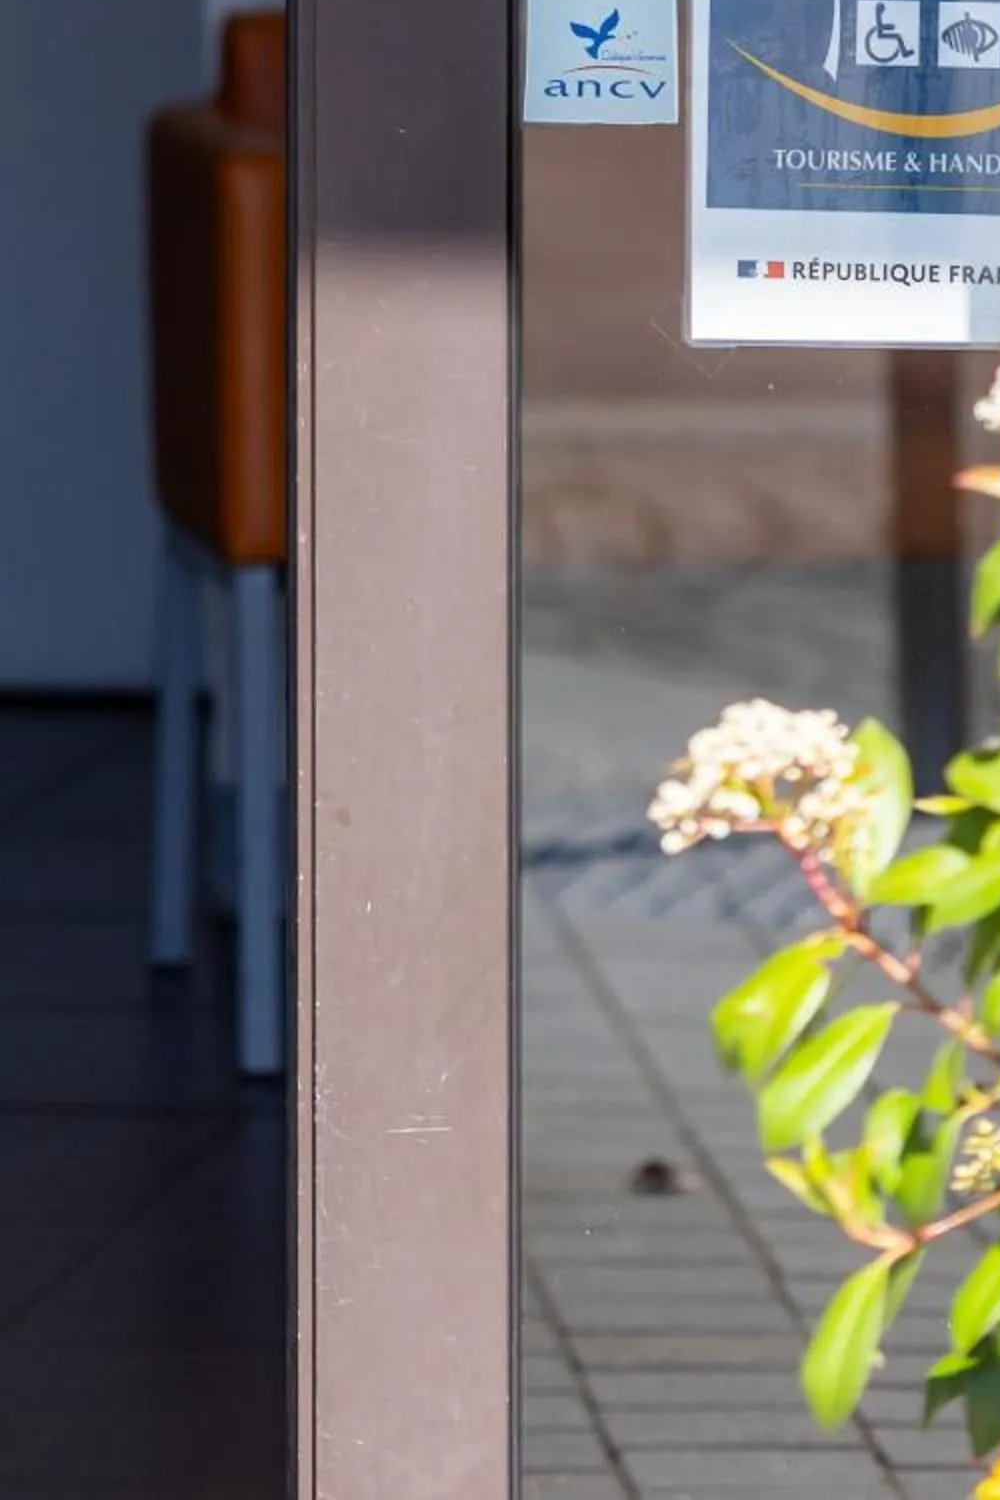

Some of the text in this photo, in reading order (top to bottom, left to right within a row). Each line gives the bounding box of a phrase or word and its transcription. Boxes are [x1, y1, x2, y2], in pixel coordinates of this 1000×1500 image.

[544, 78, 667, 99] ancv
[773, 148, 898, 172] TOURISME
[904, 152, 922, 172] &
[793, 257, 940, 286] RÉPUBLIQUE
